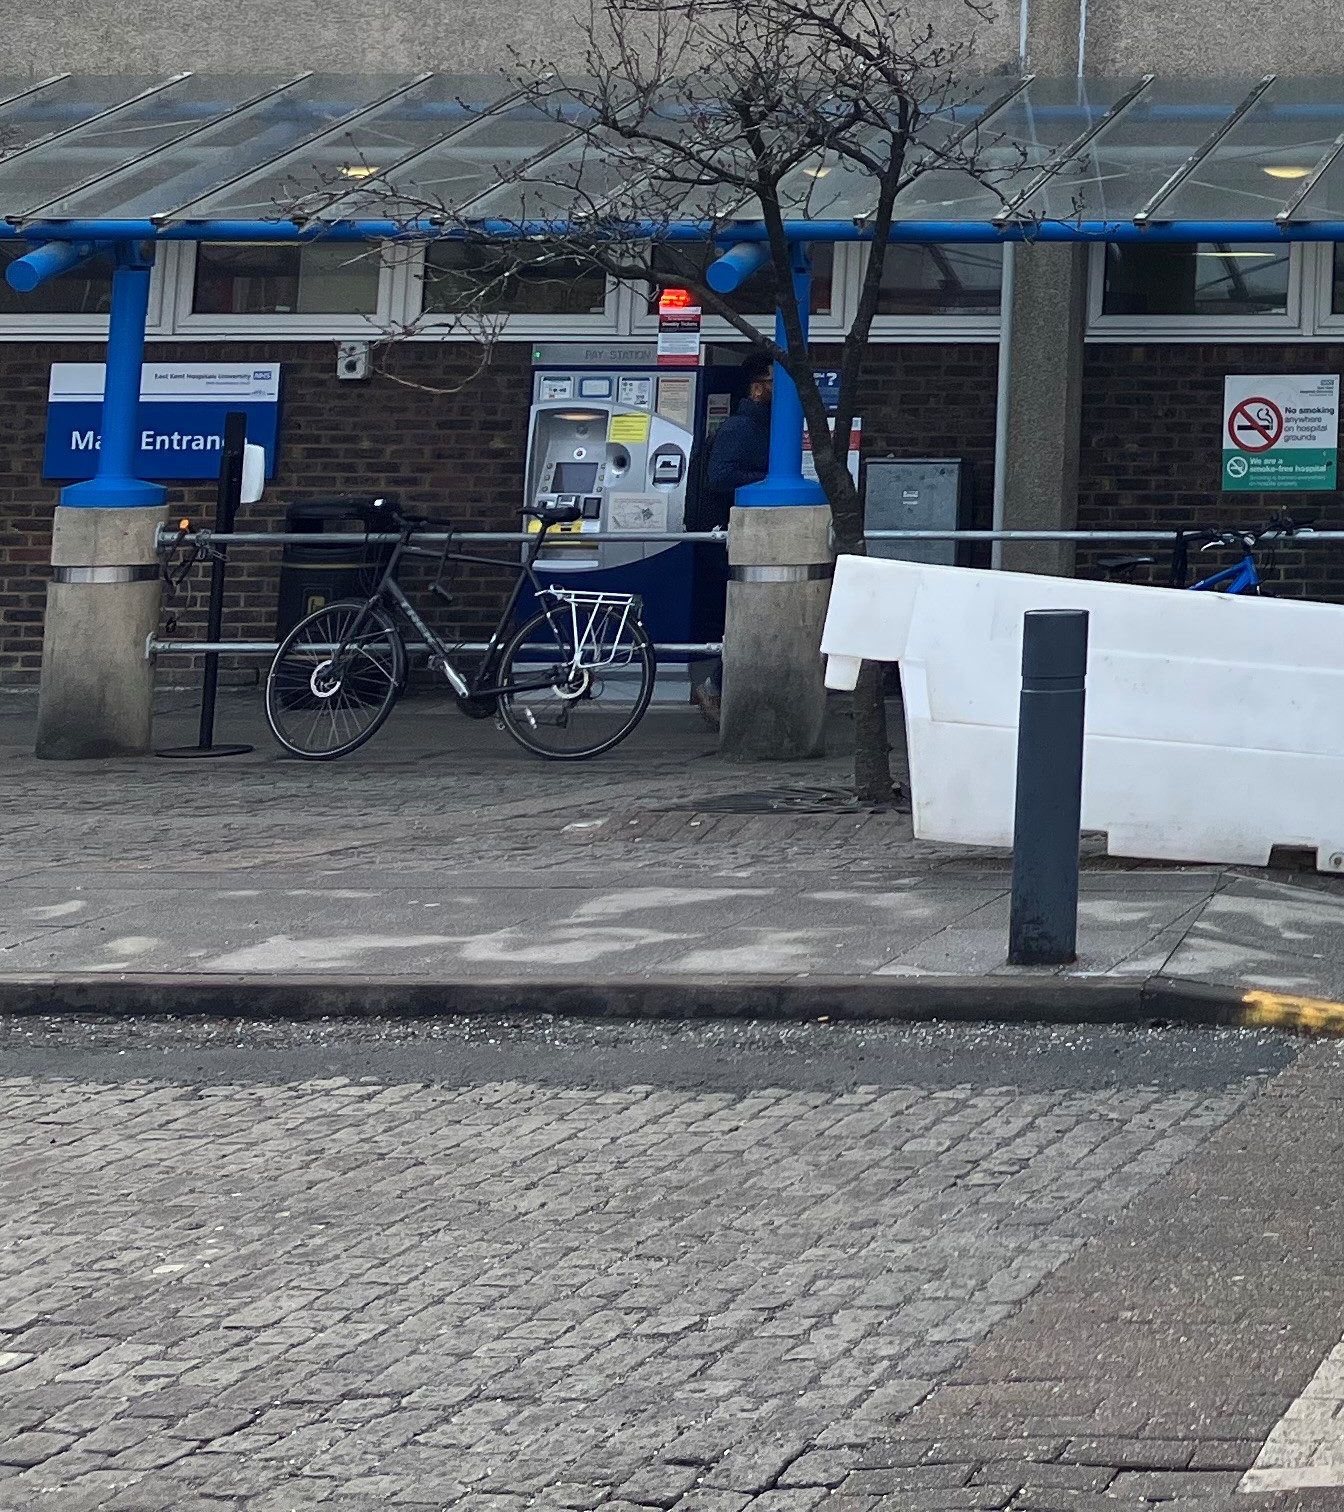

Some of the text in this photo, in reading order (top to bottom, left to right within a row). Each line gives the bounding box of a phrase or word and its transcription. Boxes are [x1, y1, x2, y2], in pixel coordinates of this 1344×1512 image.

[585, 350, 651, 360] PAY STATION
[253, 371, 272, 380] NHS
[1299, 407, 1335, 415] smoking
[1284, 416, 1322, 424] anywhere
[1296, 424, 1328, 433] hospital
[71, 430, 225, 450] Ma Entran
[1284, 433, 1317, 442] grounds
[1249, 457, 1262, 465] We
[1249, 464, 1327, 473] smoke-free hospital
